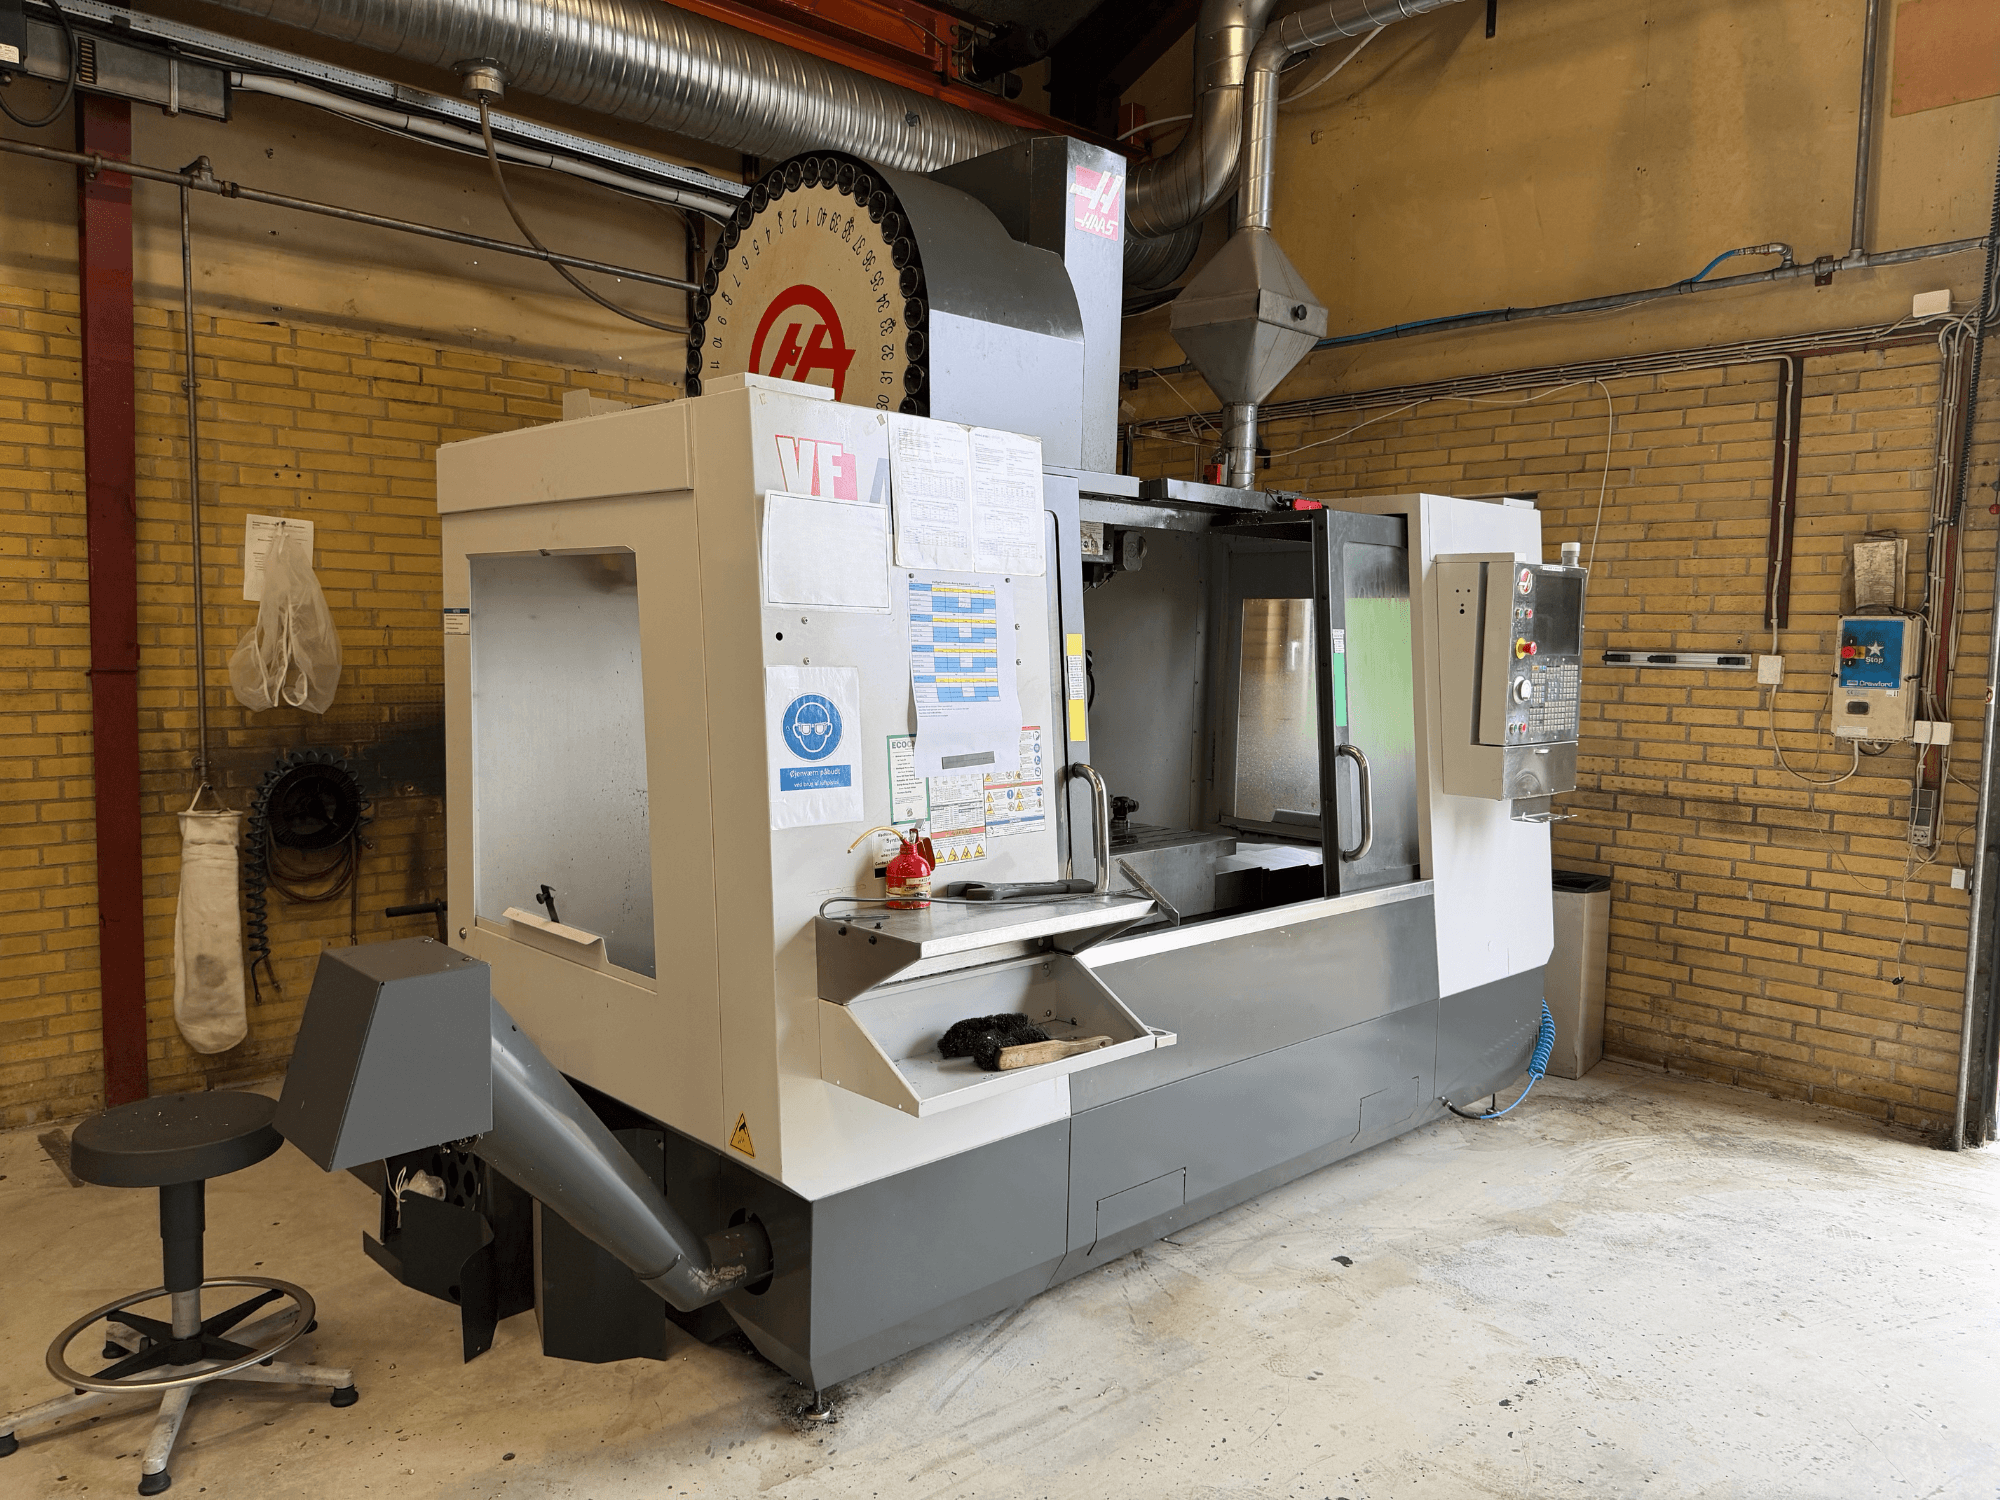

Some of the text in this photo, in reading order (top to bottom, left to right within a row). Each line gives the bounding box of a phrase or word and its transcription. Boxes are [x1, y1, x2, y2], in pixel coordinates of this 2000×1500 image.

[777, 211, 784, 235] 3
[792, 209, 798, 229] 2
[805, 206, 811, 226] 1
[816, 207, 828, 228] 40
[829, 211, 842, 234] 39
[1075, 212, 1119, 236] HAAS
[765, 226, 771, 245] 4
[841, 220, 855, 243] 38
[752, 239, 760, 256] 5
[852, 234, 866, 256] 37
[741, 255, 750, 270] 6
[862, 250, 876, 272] 36
[732, 273, 742, 288] 7
[870, 270, 885, 292] 35
[721, 291, 733, 306] 8
[876, 293, 890, 313] 34
[717, 315, 728, 326] 9
[880, 317, 893, 337] 33
[712, 336, 723, 349] 10
[881, 343, 895, 361] 32
[710, 360, 720, 370] 11
[880, 370, 893, 384] 31
[1865, 656, 1884, 665] Stop
[1859, 680, 1893, 688] Crawford
[819, 768, 841, 776] påbudt
